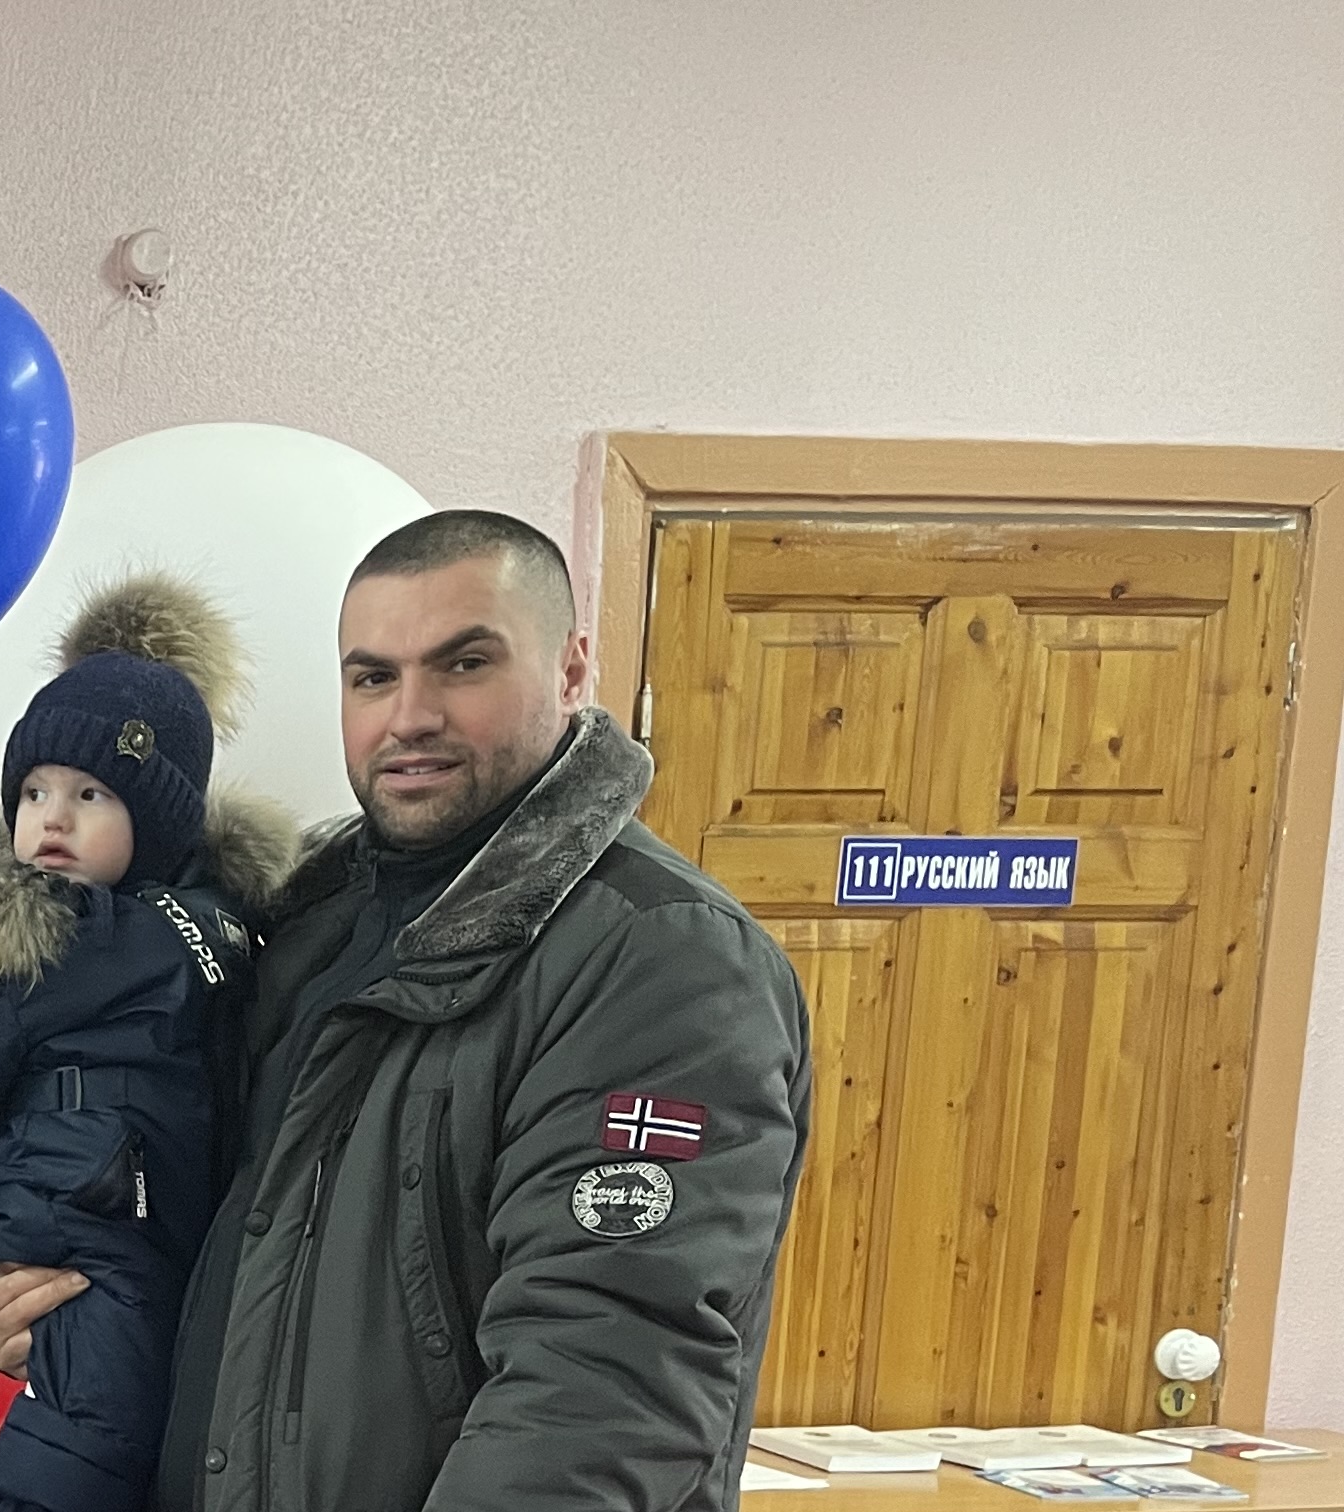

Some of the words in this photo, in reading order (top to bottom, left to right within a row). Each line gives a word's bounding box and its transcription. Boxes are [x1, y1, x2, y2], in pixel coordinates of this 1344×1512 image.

[854, 856, 894, 887] 111
[901, 851, 1000, 889] РУССКИЙ
[1009, 856, 1070, 889] ЯЗЫК
